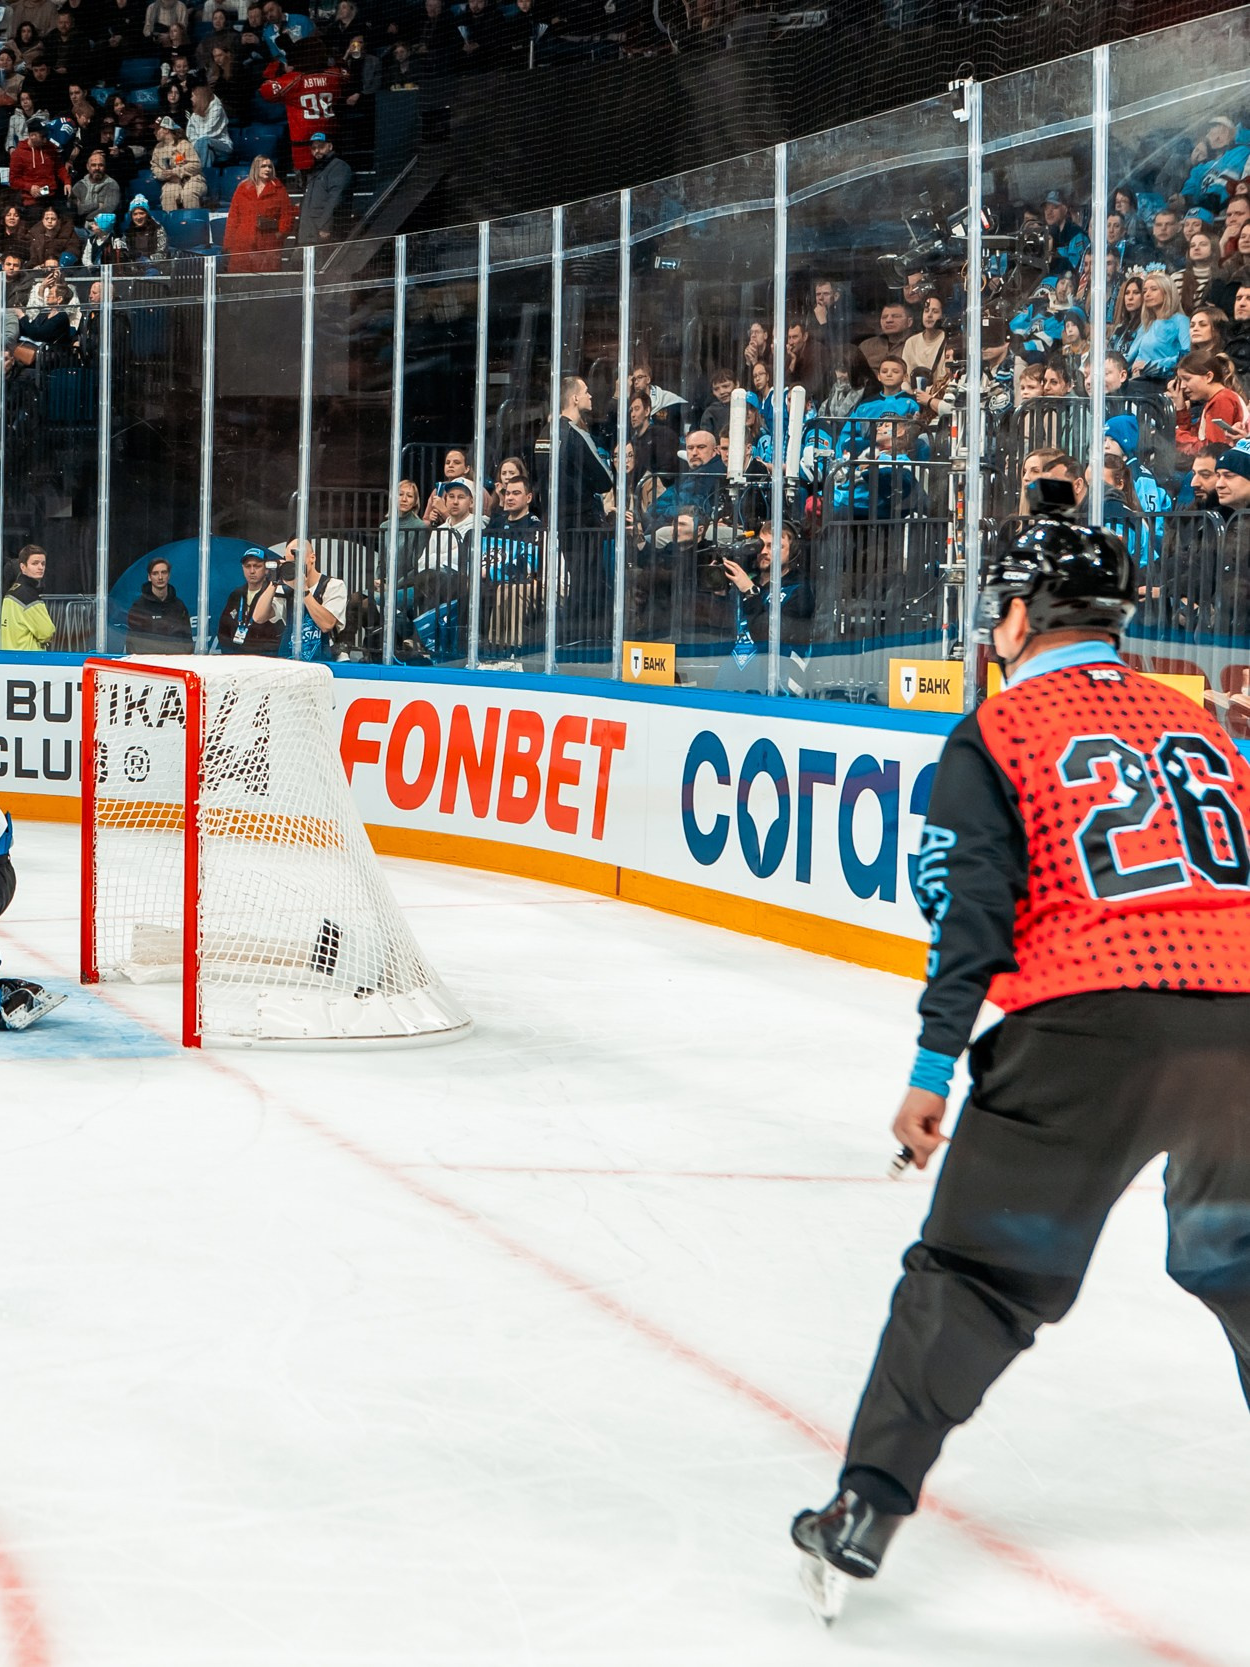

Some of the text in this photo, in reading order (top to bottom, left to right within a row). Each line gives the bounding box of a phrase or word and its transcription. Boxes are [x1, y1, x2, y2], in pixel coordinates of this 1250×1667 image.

[643, 657, 666, 672] БАНК
[919, 678, 950, 695] БАНК
[340, 697, 627, 840] FONBET
[1055, 731, 1250, 902] 26
